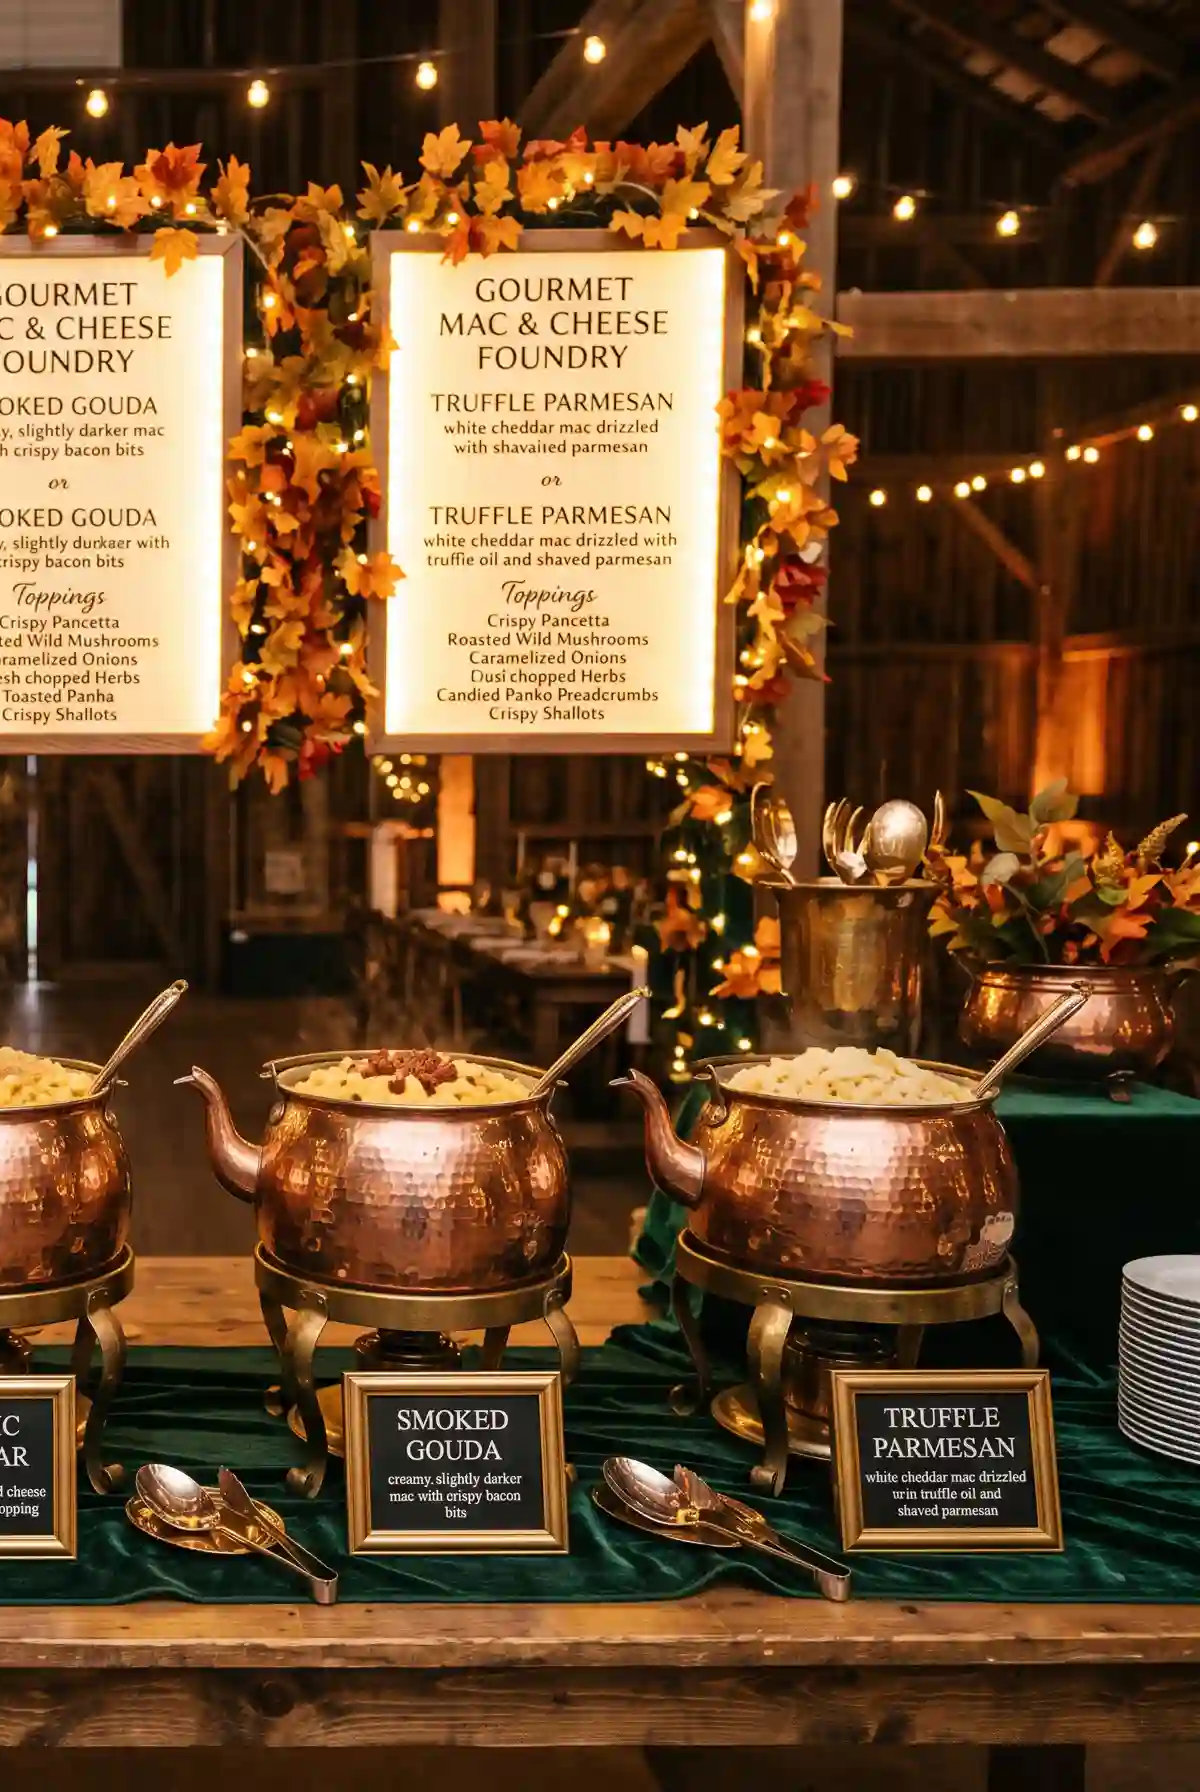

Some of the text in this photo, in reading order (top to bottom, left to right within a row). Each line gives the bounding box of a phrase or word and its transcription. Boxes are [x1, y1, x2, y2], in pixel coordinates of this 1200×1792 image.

[476, 277, 633, 302] GOURMET
[26, 316, 45, 340] &
[56, 316, 171, 340] CHEESE
[440, 311, 668, 336] MAC & CHEESE
[479, 345, 628, 370] FOUNDRY
[72, 396, 157, 415] GOUDA
[431, 393, 672, 412] TRUFFLE PARMESAN
[18, 423, 74, 441] slightly
[79, 423, 128, 437] darker
[134, 427, 164, 436] mac
[444, 419, 658, 434] white cheddar mac drizzled
[14, 443, 59, 460] crispy
[64, 443, 110, 456] bacon
[116, 442, 144, 456] bits
[454, 440, 487, 453] with
[572, 444, 647, 457] parmesan
[48, 479, 68, 489] or
[541, 476, 562, 486] or
[72, 508, 156, 527] GOUDA
[430, 506, 670, 525] TRUFFLE PARMESAN
[13, 536, 68, 553] slightly
[137, 536, 169, 549] with
[424, 532, 677, 548] white cheddar mac drizzled with
[45, 554, 91, 568] bacon
[96, 554, 124, 568] bits
[480, 552, 497, 566] oil
[503, 552, 531, 566] and
[537, 552, 590, 566] shaved
[596, 556, 671, 569] parmesan
[12, 582, 104, 614] Toppings
[502, 580, 597, 612] Toppings
[0, 615, 119, 633] Crispy Pancetta
[488, 614, 609, 630] Crispy Pancetta
[27, 633, 62, 647] Wild
[68, 633, 158, 648] Mushrooms
[448, 632, 648, 646] Roasted Wild Mushrooms
[83, 652, 137, 666] Onions
[470, 651, 627, 664] Caramelized Onions
[25, 670, 90, 688] chopped
[96, 671, 140, 684] Herbs
[510, 669, 575, 687] chopped
[582, 668, 625, 684] Herbs
[3, 689, 61, 704] Toasted
[437, 688, 658, 702] Candied Panko Preadcrumbs
[2, 708, 117, 725] Crispy Shallots
[489, 706, 604, 724] Crispy Shallots
[398, 1410, 508, 1430] SMOKED
[884, 1407, 1000, 1428] TRUFFLE
[407, 1440, 502, 1460] GOUDA
[873, 1437, 1015, 1458] PARMESAN
[436, 1472, 480, 1488] slightly
[484, 1472, 522, 1484] darker
[865, 1470, 1026, 1483] white cheddar mac drizzled
[7, 1485, 46, 1497] cheese
[389, 1490, 520, 1504] mac with crispy bacon
[921, 1488, 957, 1499] truffle
[961, 1488, 976, 1499] oil
[980, 1488, 1002, 1499] and
[445, 1506, 467, 1518] bits
[898, 1504, 998, 1519] shaved parmesan
